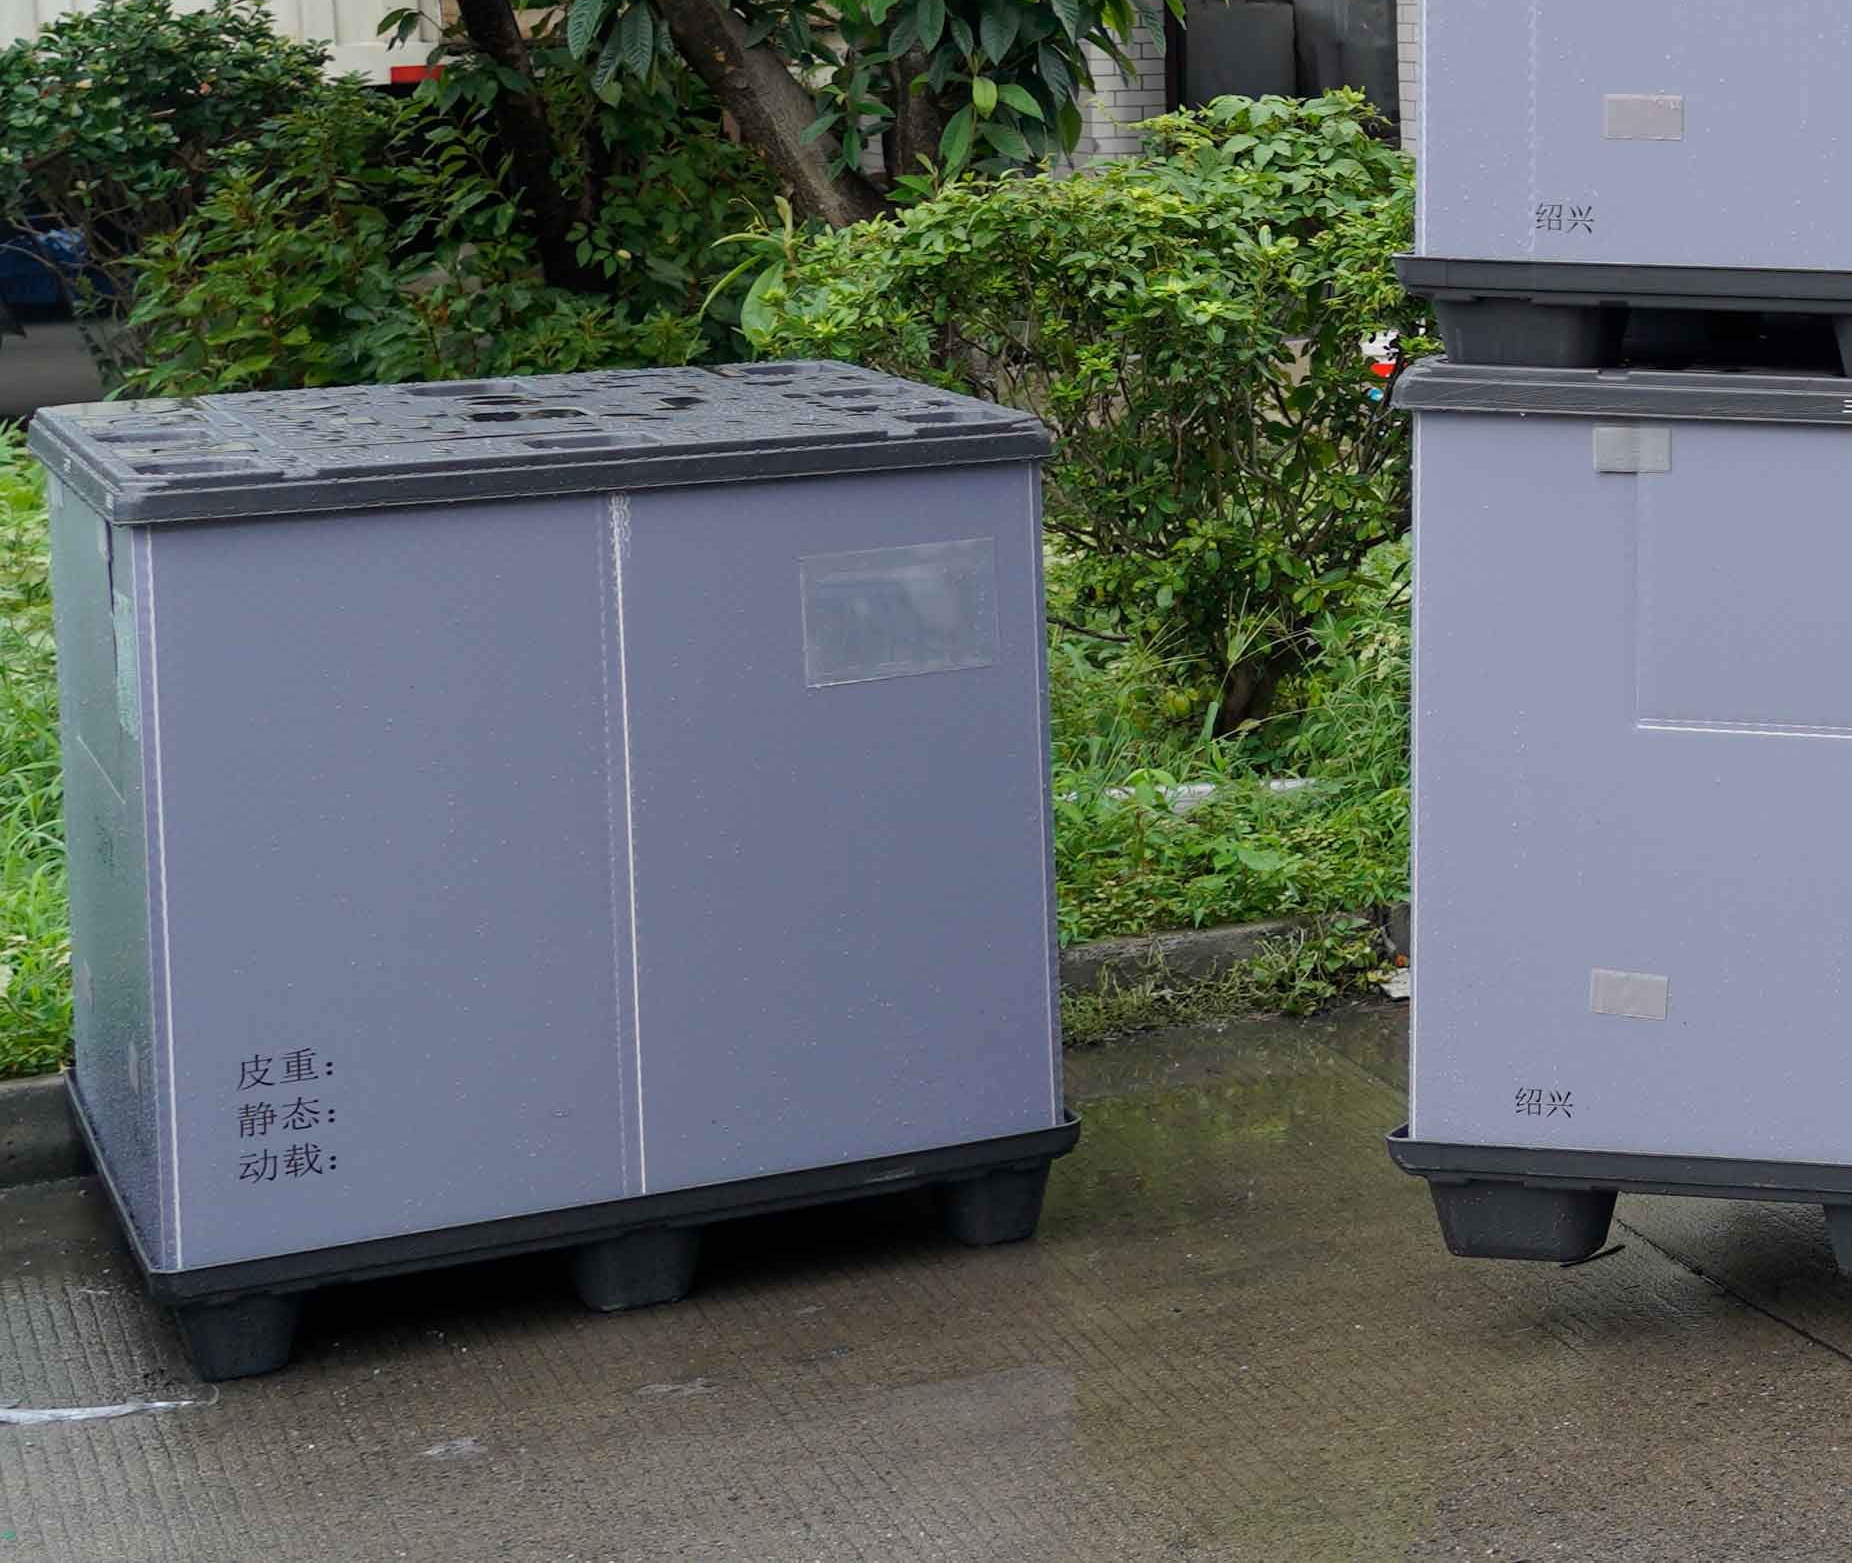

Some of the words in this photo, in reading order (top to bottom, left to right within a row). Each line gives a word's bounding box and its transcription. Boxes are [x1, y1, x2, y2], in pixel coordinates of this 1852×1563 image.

[1535, 203, 1595, 234] 绍兴
[236, 1047, 336, 1092] 皮重：
[236, 1096, 337, 1140] 静态：
[1514, 1087, 1574, 1119] 绍兴
[237, 1142, 338, 1184] 动载：
